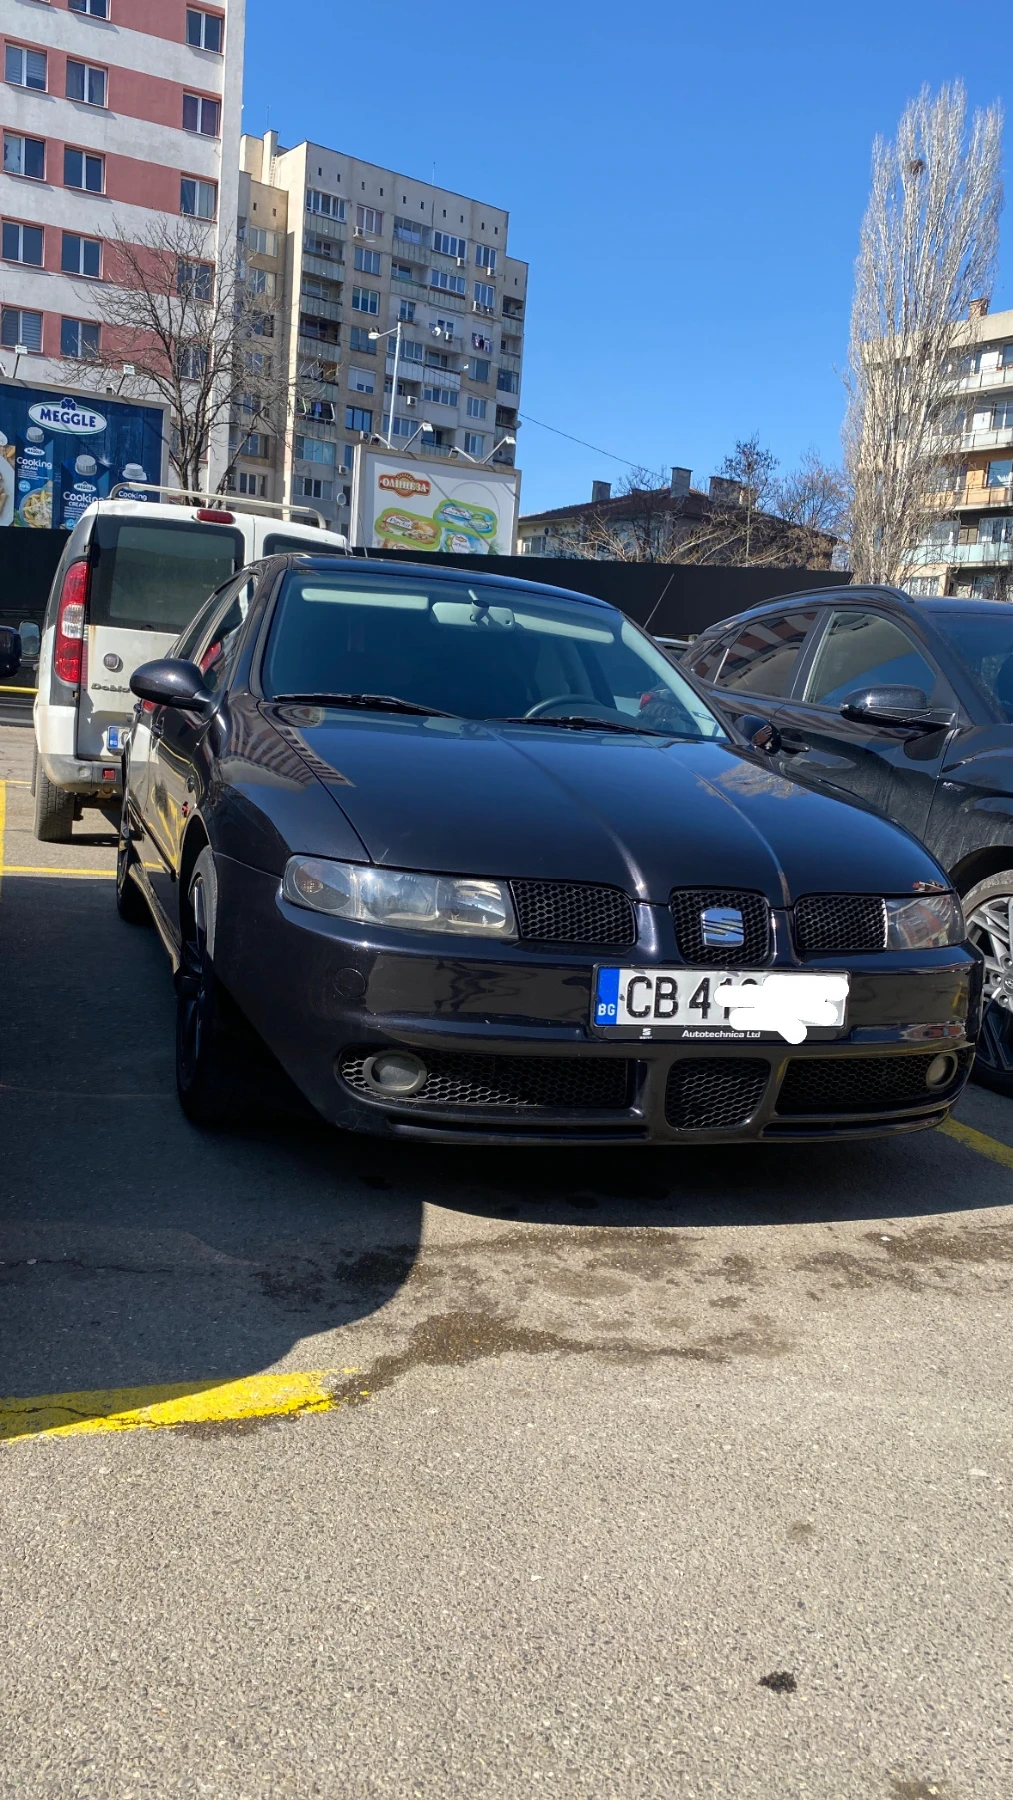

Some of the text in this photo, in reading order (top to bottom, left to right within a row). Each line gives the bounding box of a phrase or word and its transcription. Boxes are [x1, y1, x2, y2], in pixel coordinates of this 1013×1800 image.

[40, 408, 96, 428] MEGGLE
[16, 457, 52, 469] Cooking
[118, 491, 147, 501] Cooking
[626, 976, 679, 1019] CB
[597, 1003, 616, 1017] BG
[681, 1029, 761, 1039] Autotechnica Ltd
